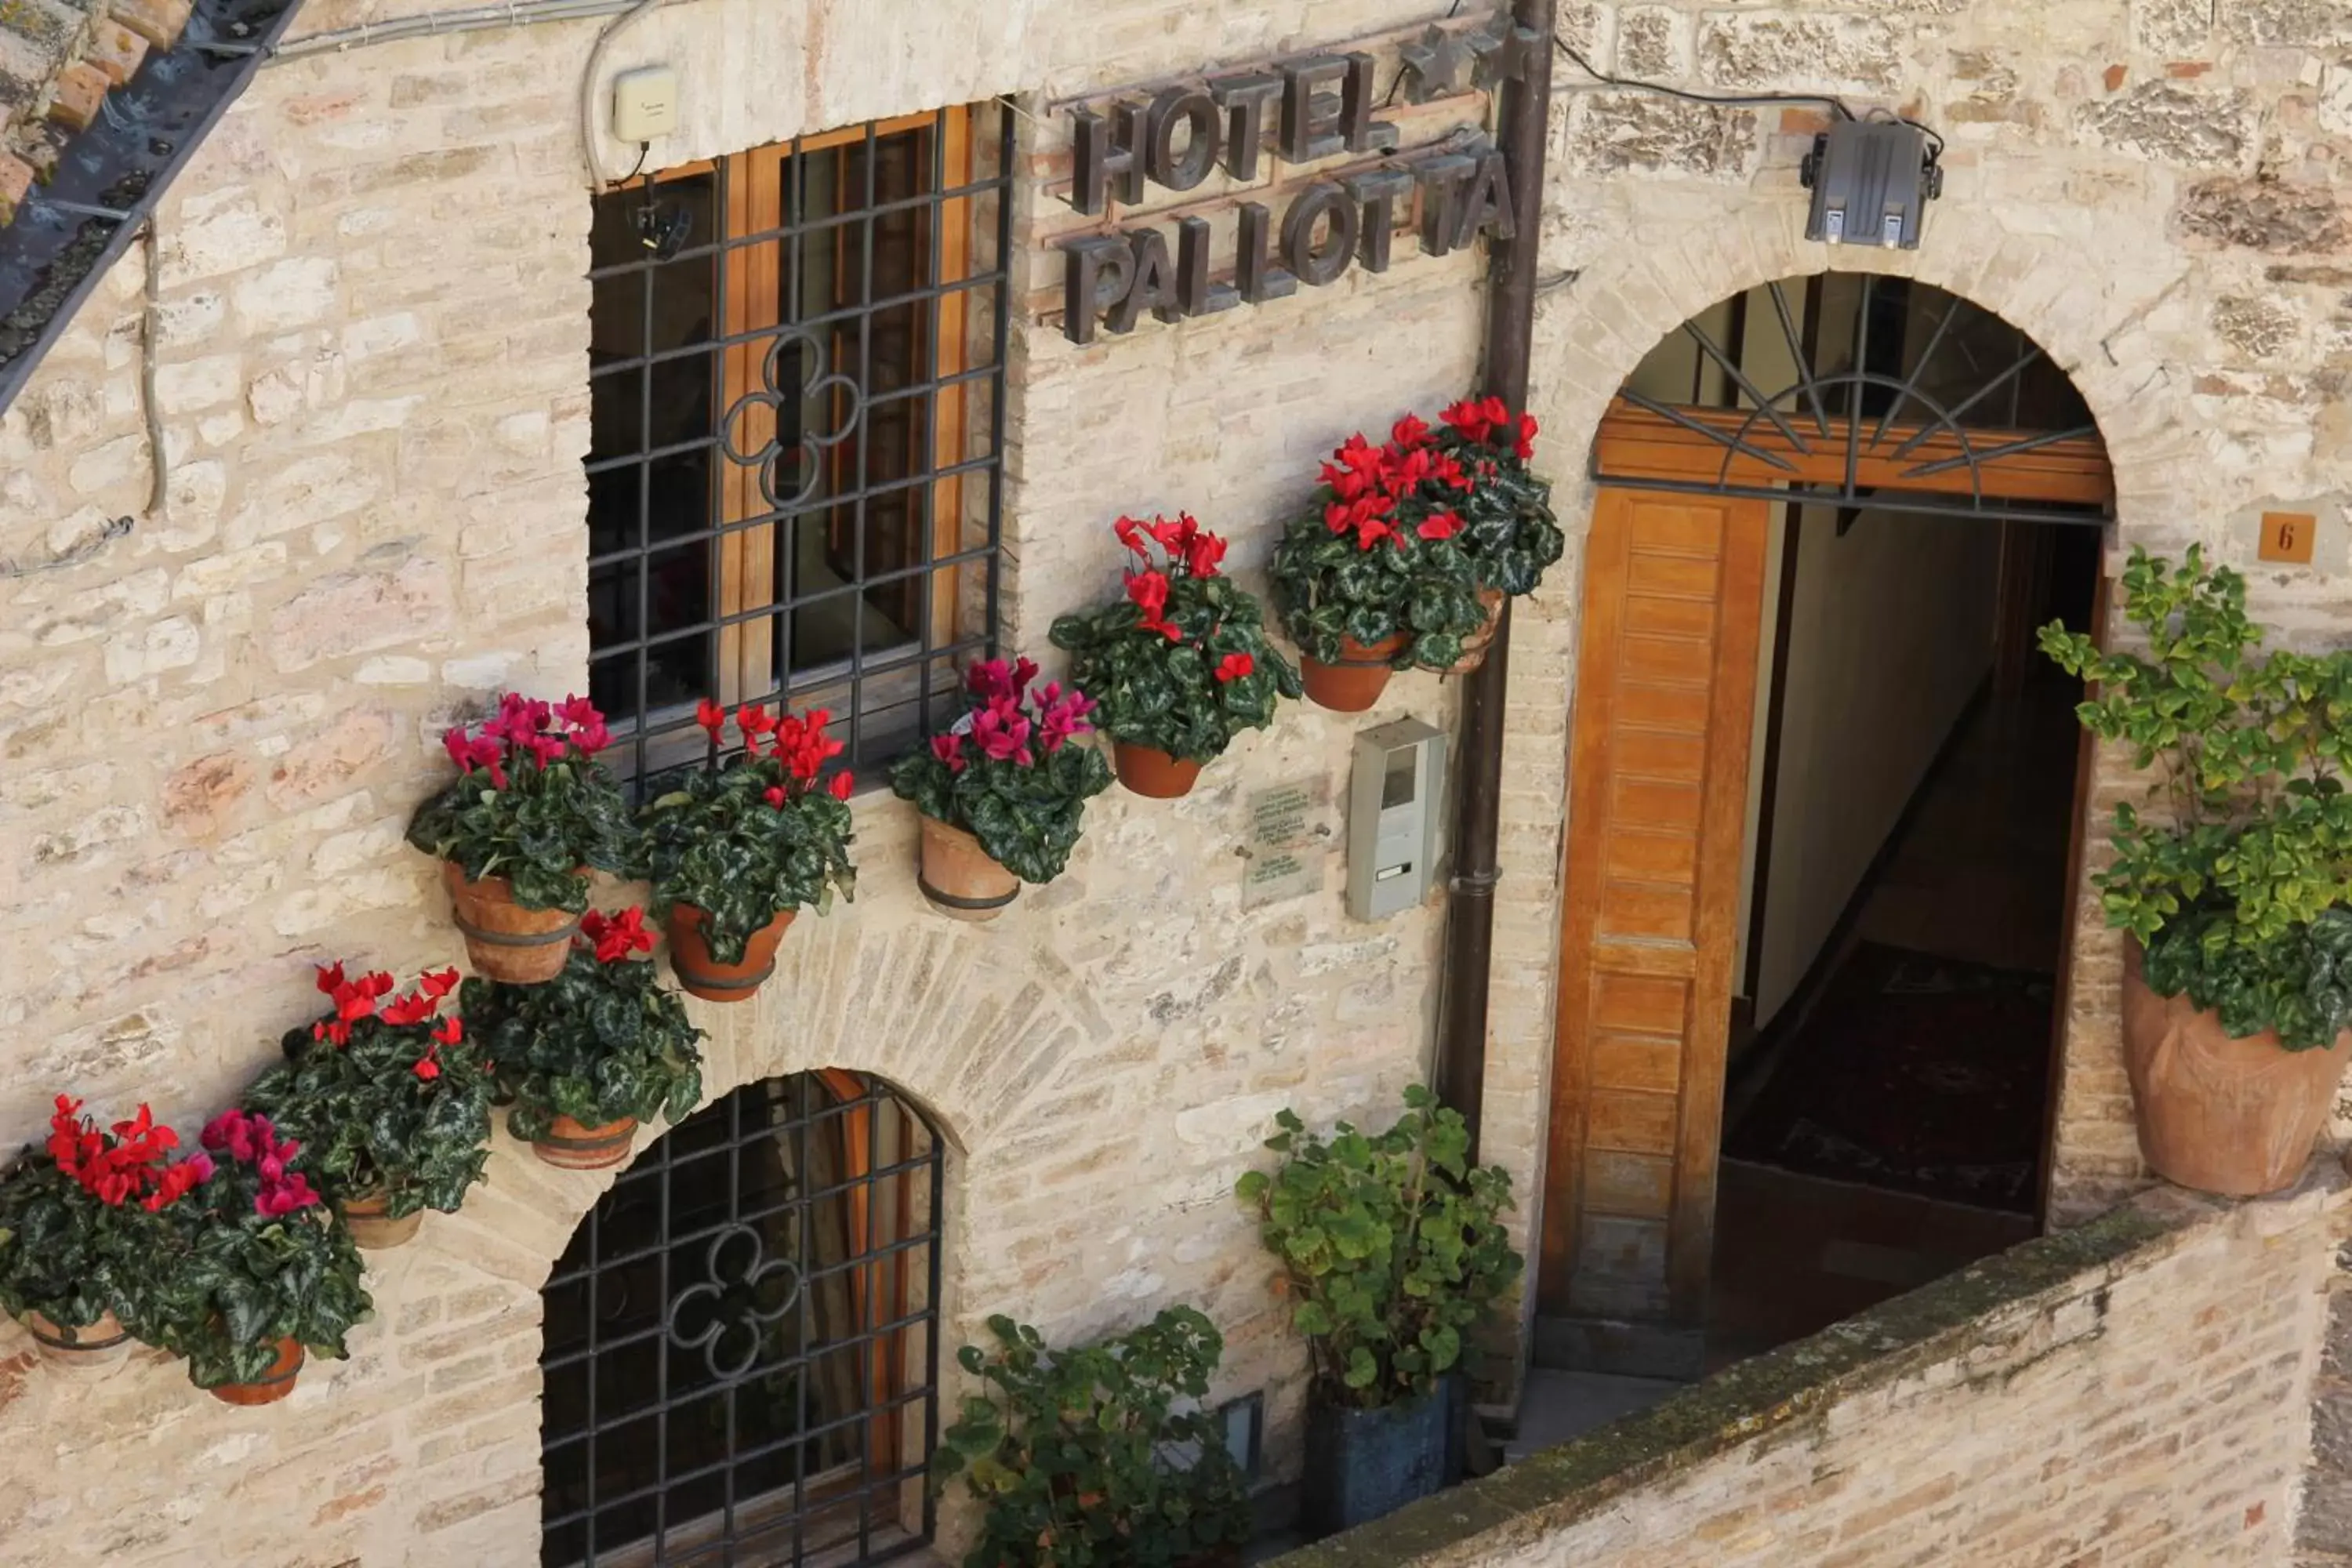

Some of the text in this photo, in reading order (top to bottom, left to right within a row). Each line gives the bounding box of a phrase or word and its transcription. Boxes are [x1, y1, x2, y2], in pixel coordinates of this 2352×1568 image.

[1069, 51, 1400, 216] HOTEL
[1062, 143, 1515, 345] PALLOTTA
[2278, 522, 2294, 550] 6
